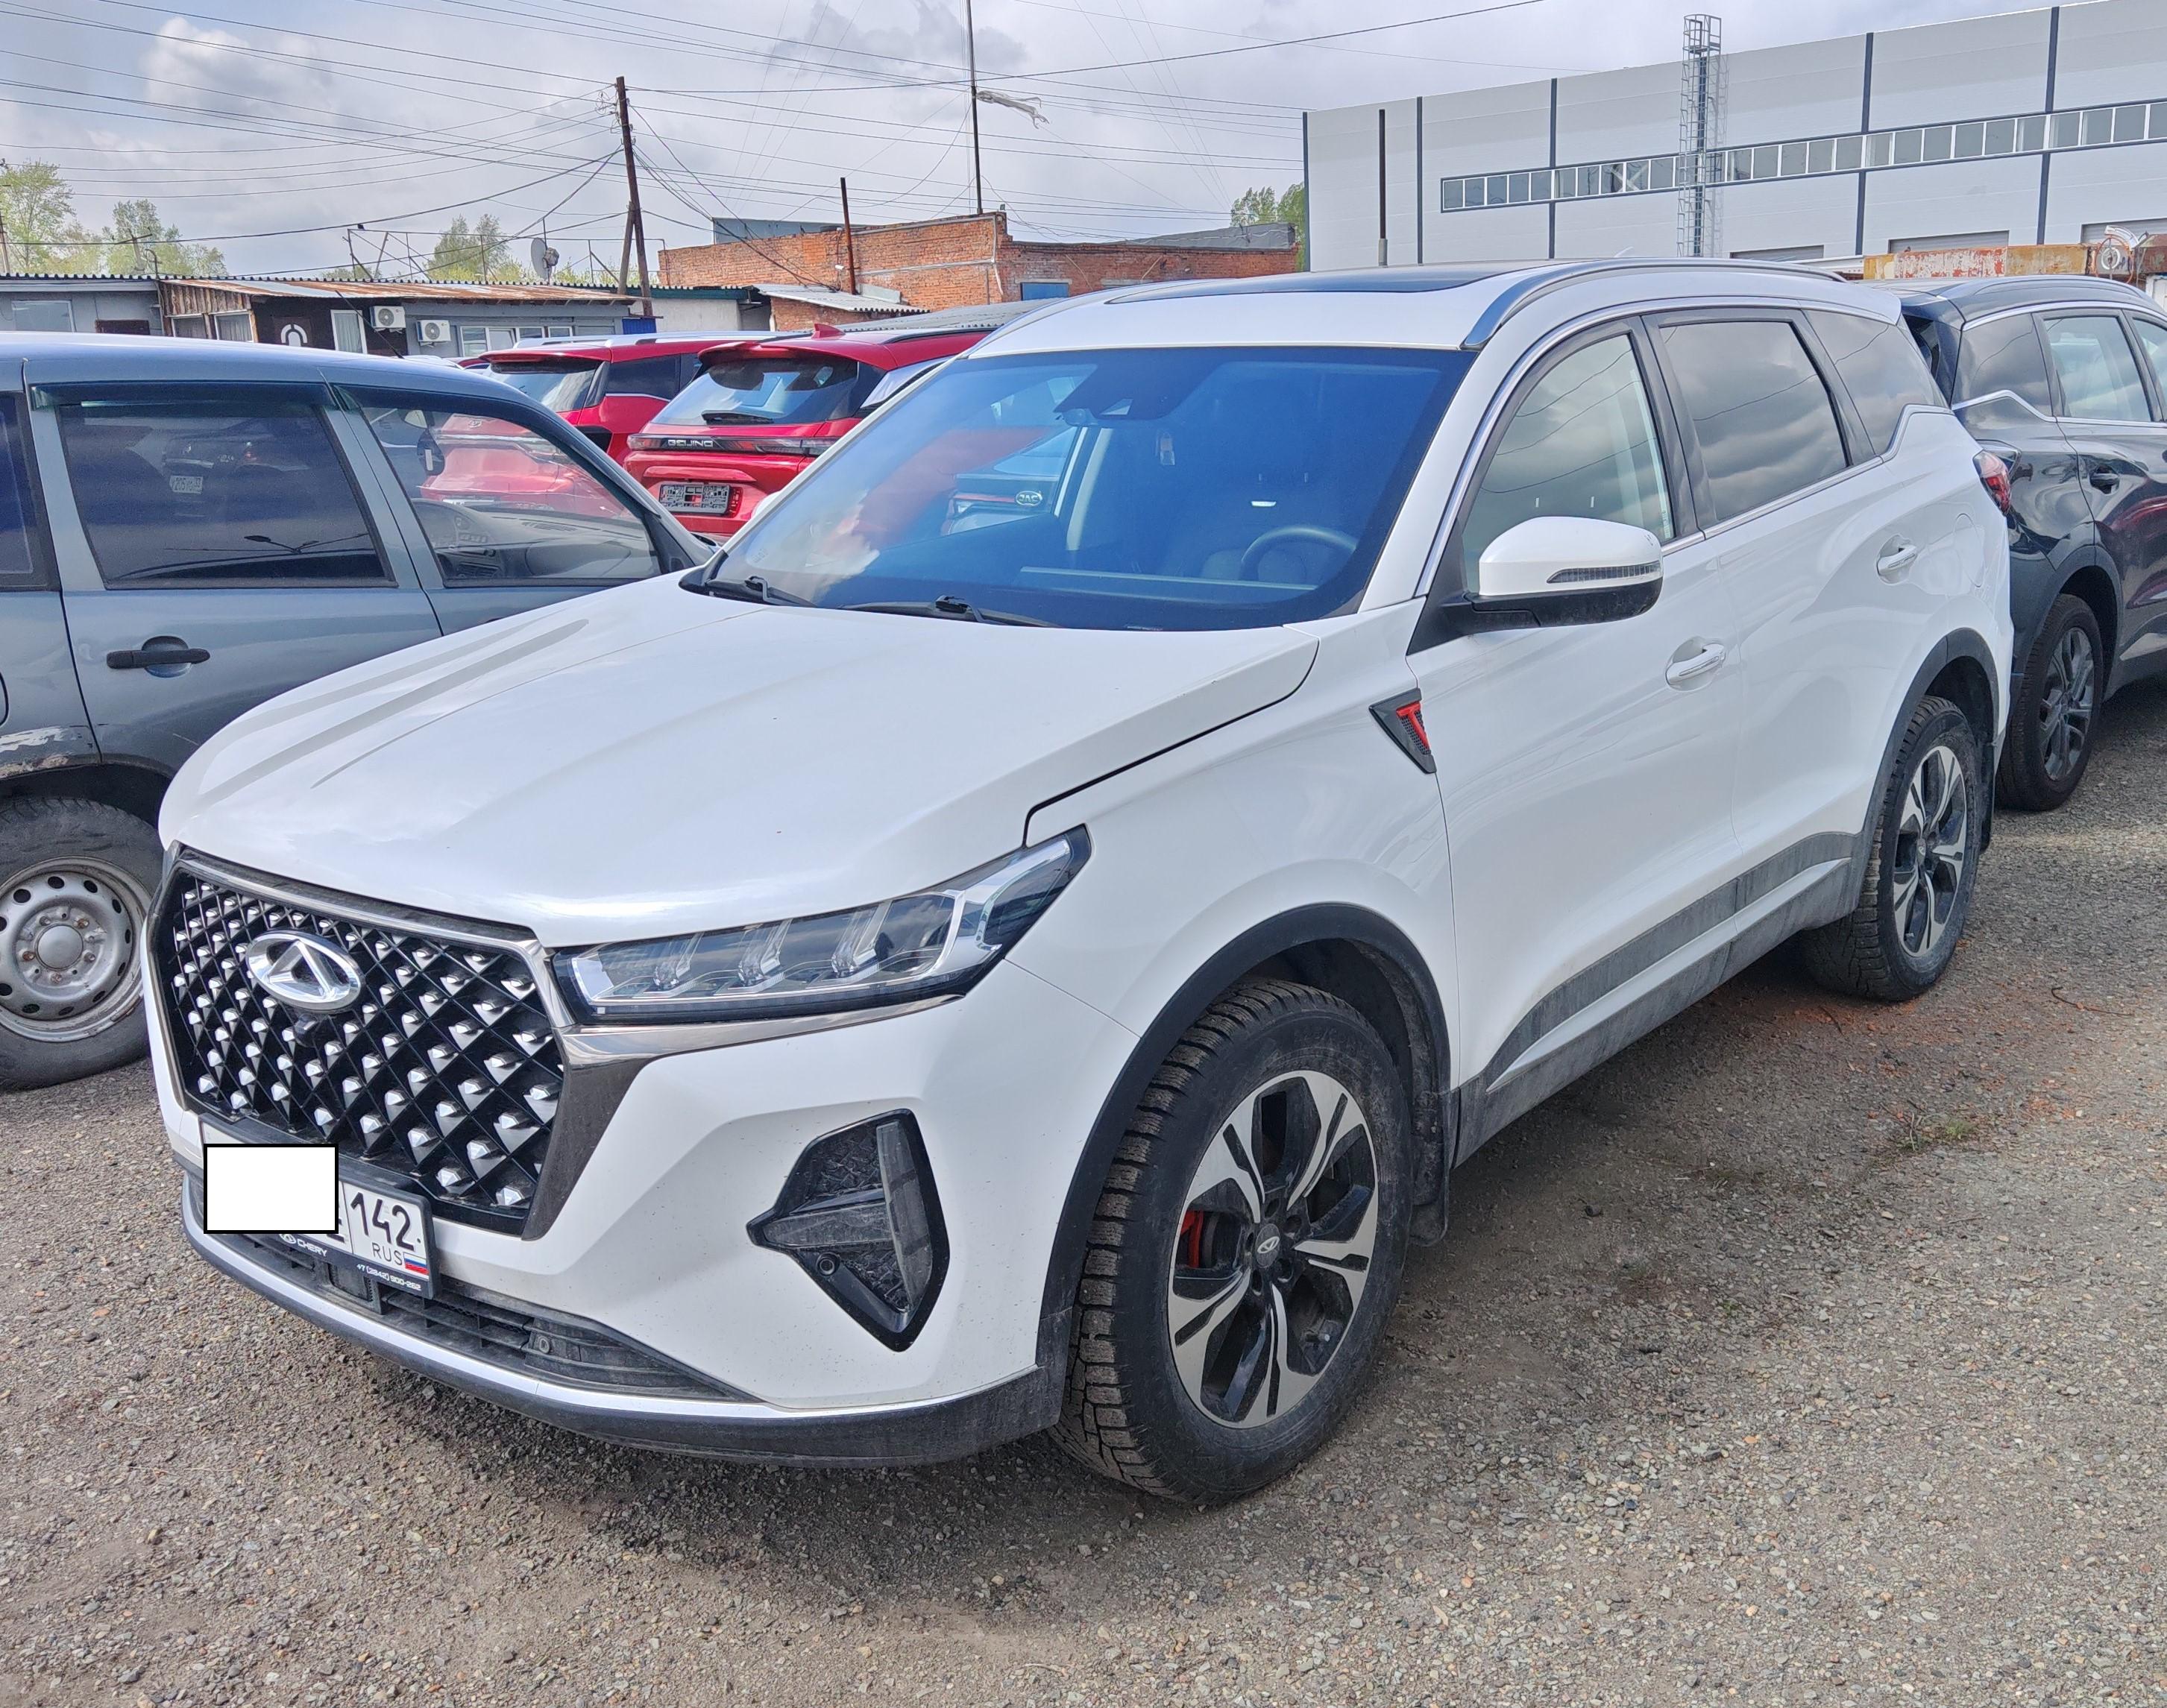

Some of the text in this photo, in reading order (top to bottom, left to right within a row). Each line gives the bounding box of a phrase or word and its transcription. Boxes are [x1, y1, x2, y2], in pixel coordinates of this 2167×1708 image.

[350, 1191, 415, 1252] 142
[297, 1239, 327, 1257] CHERY
[372, 1242, 403, 1265] RUS
